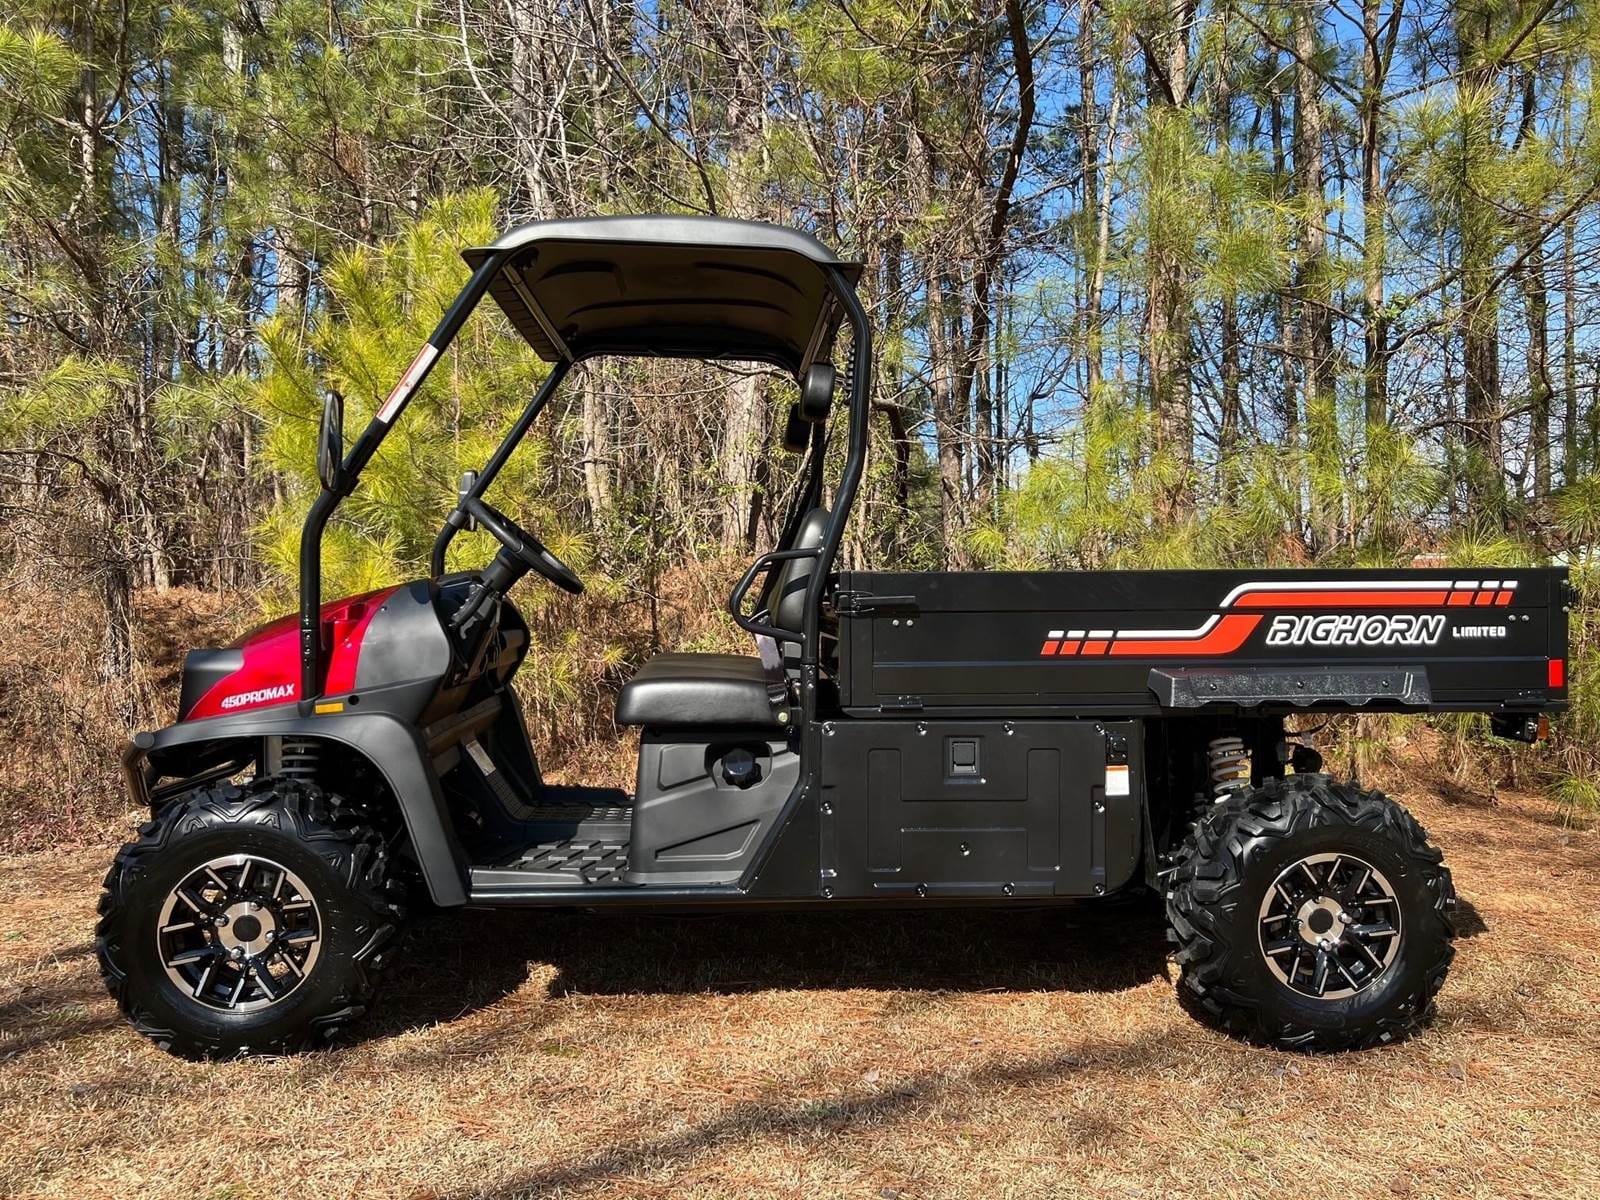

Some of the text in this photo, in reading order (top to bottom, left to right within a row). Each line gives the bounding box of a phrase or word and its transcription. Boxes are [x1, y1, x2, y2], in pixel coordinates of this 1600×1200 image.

[1266, 615, 1506, 645] BIGHORN LIMITED
[221, 683, 295, 709] 450PROMAX
